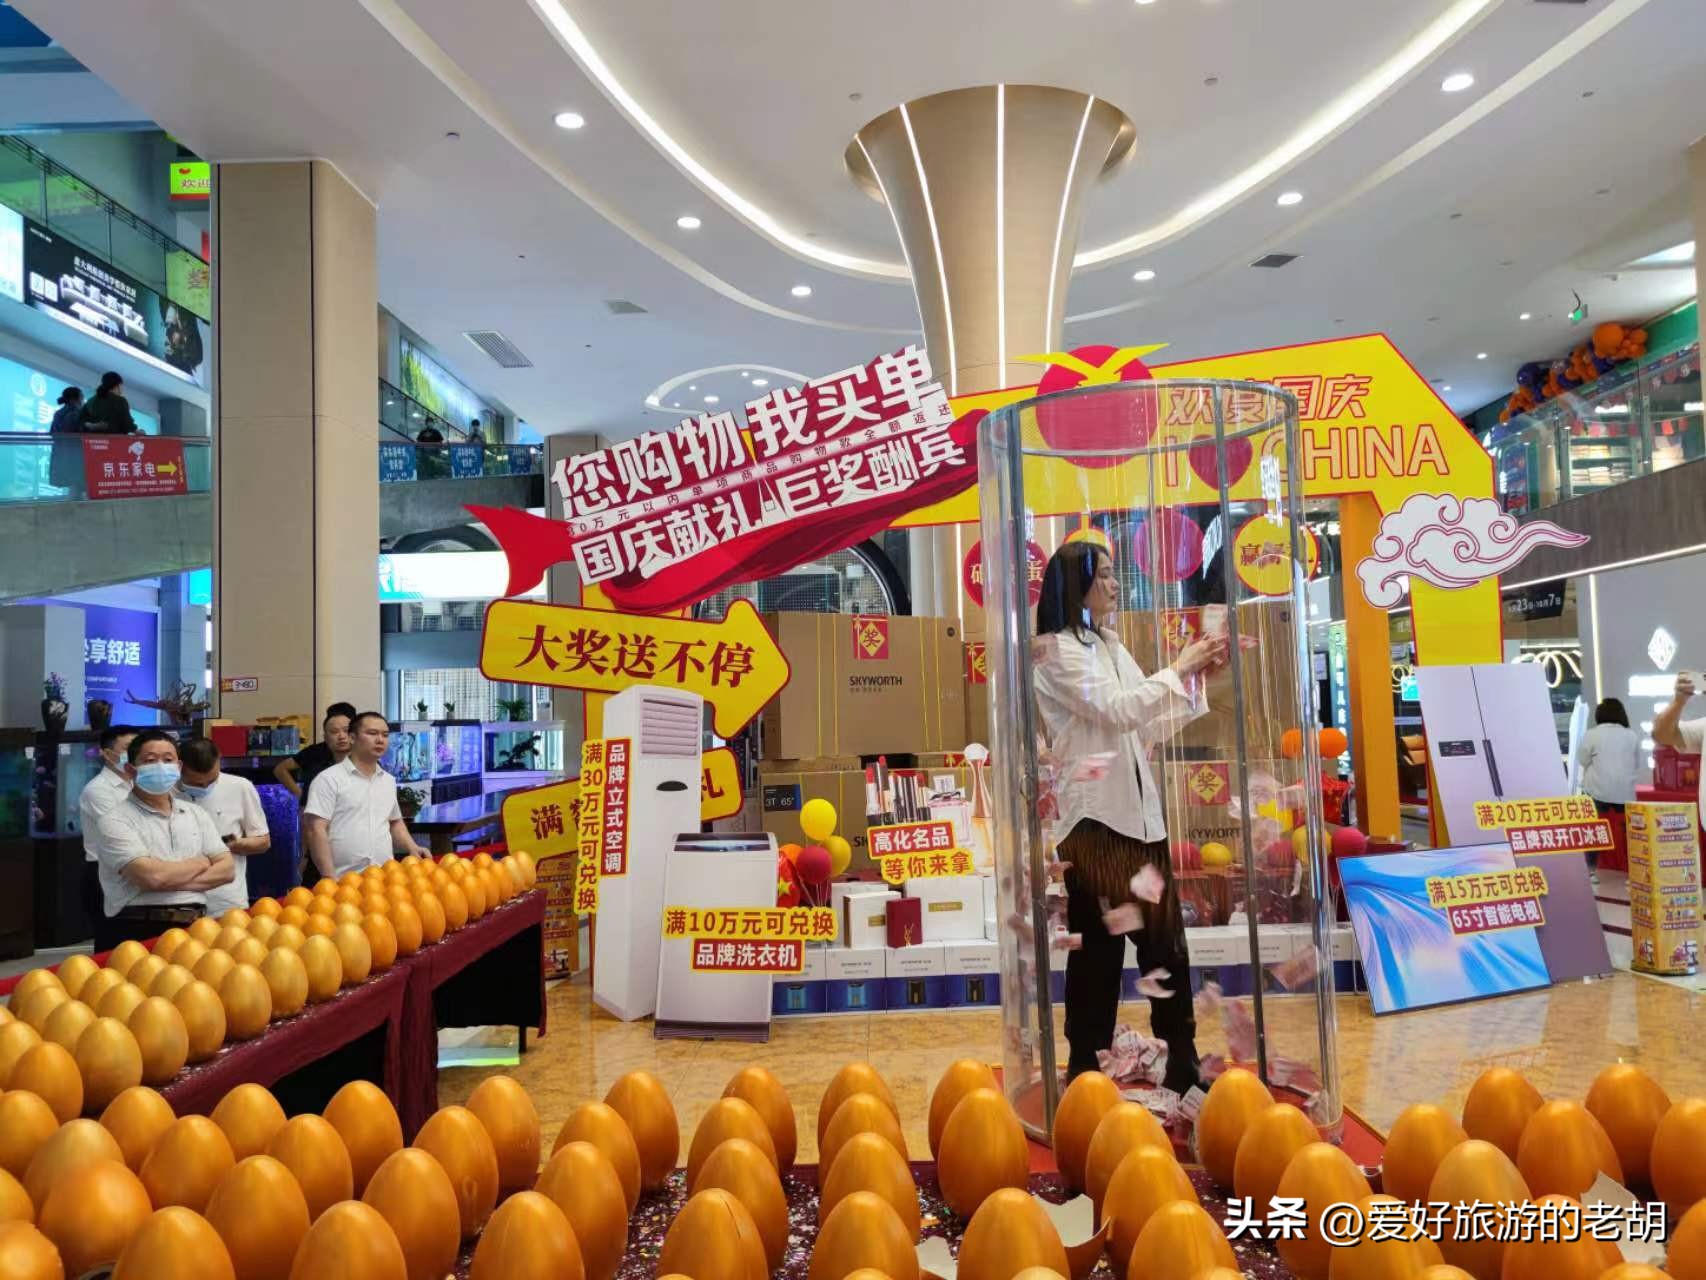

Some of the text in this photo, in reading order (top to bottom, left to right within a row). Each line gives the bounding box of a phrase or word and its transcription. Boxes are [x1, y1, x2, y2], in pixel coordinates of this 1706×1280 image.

[551, 344, 942, 520] 您购物我买单
[104, 462, 156, 478] 京东家电
[863, 627, 882, 648] 奖
[514, 625, 756, 688] 大奖送不停
[849, 676, 903, 687] SKYWORTH
[1197, 772, 1219, 793] 奖
[605, 744, 625, 873] 品牌立式空调
[1477, 799, 1597, 827] 满20万元可兑换
[579, 743, 603, 910] 满30万元可兑换
[1185, 827, 1243, 839] KYWORT
[1511, 825, 1609, 851] 品牌双开门冰箱
[873, 827, 950, 853] 高化名品
[885, 851, 970, 880] 等你来拿
[1428, 871, 1545, 904] 满15万元可兑换
[666, 911, 834, 937] 满10万元可兑换
[1452, 900, 1540, 928] 65寸智能电视
[696, 943, 798, 967] 品牌洗衣机
